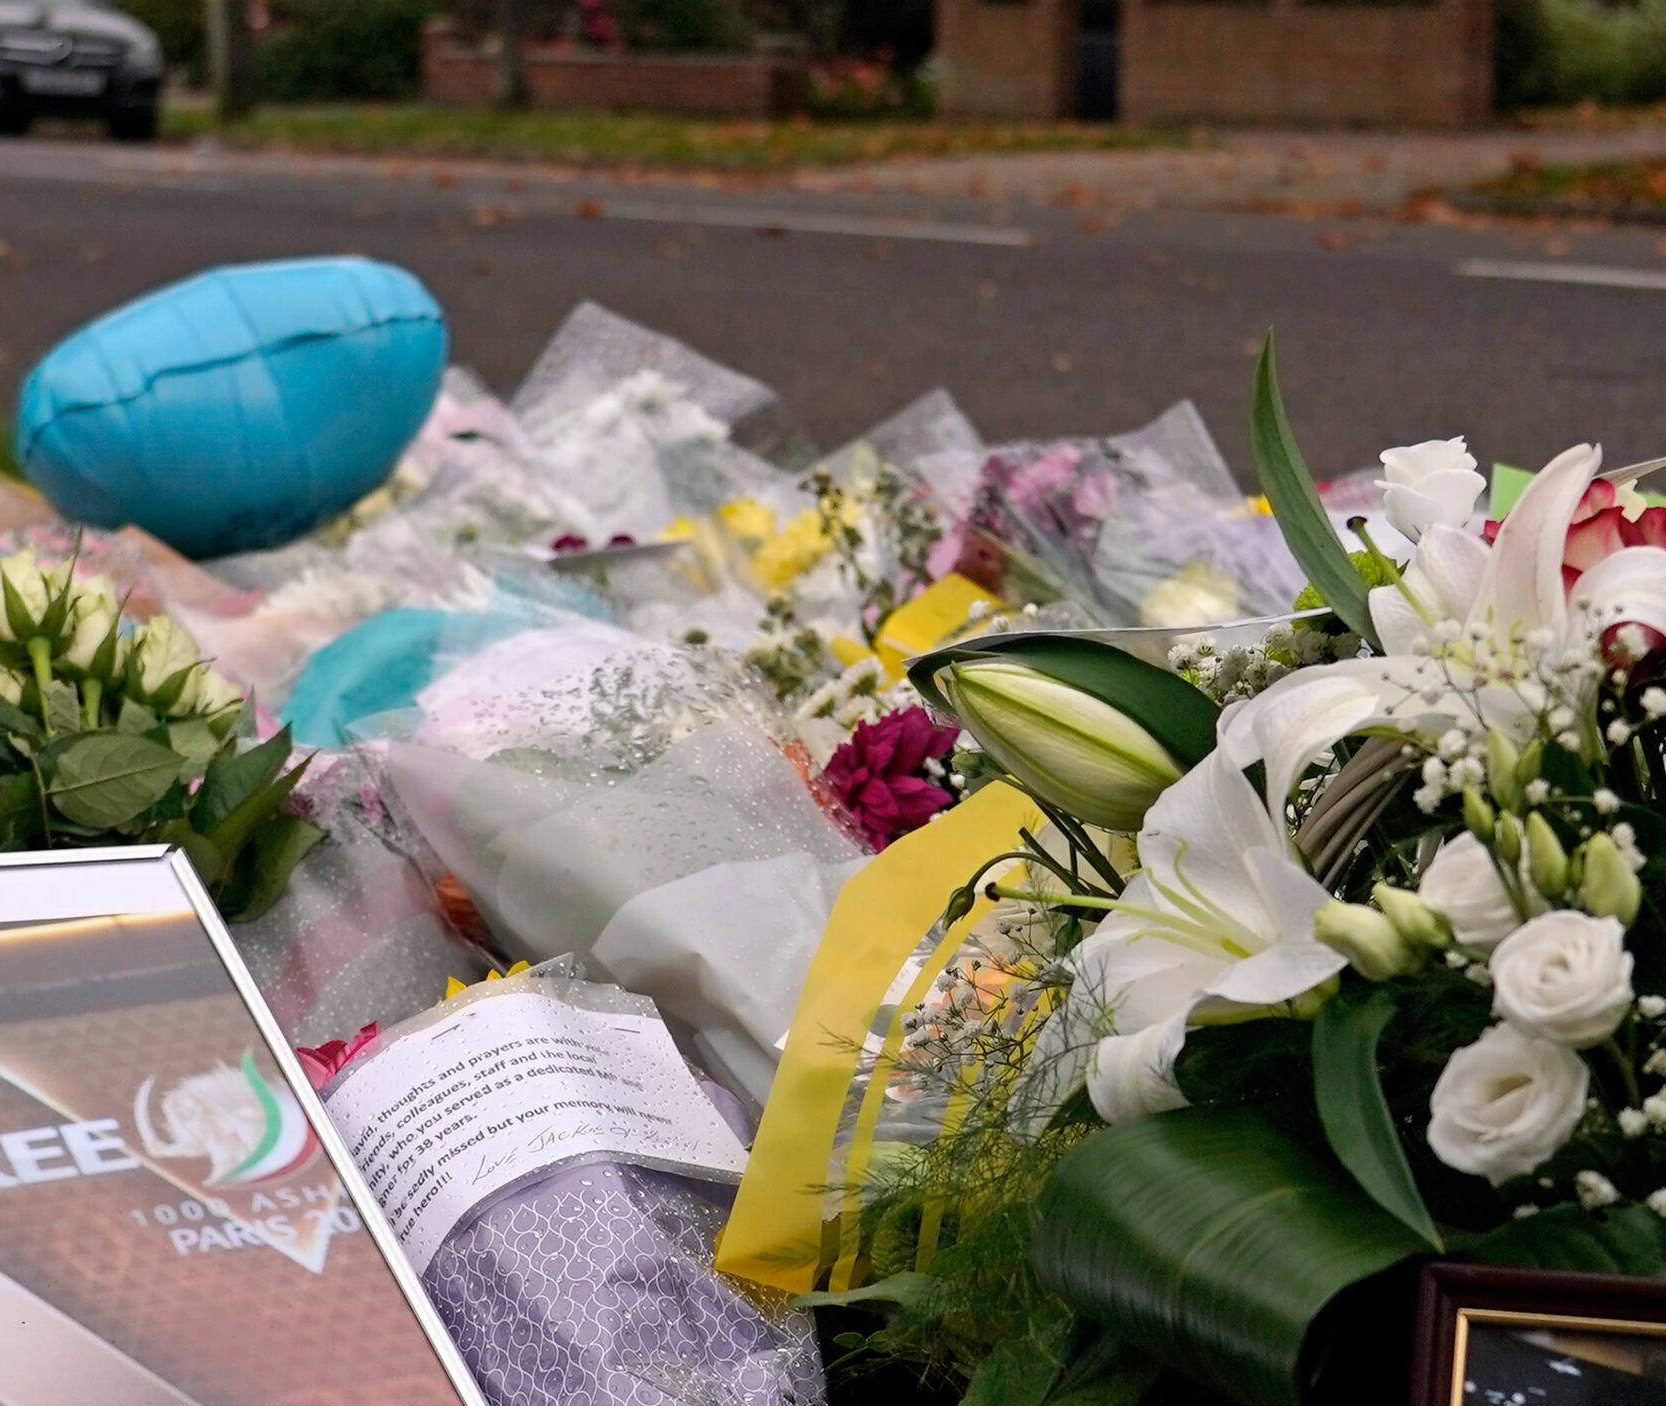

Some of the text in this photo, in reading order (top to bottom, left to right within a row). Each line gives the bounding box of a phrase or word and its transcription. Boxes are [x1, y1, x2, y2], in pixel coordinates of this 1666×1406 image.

[360, 1049, 597, 1172] riends, colleagues, staff and the local
[377, 1079, 437, 1124] thoughts
[438, 1061, 466, 1081] and
[468, 1040, 523, 1067] prayers
[525, 1036, 549, 1046] are
[551, 1036, 583, 1048] with
[369, 1162, 390, 1191] nity,
[388, 1132, 415, 1160] who
[416, 1113, 443, 1135] you
[445, 1084, 493, 1116] served
[494, 1078, 512, 1090] as
[514, 1073, 524, 1082] a
[527, 1064, 595, 1079] dedicated
[397, 1154, 416, 1175] for
[416, 1138, 434, 1157] 38
[434, 1113, 478, 1141] years.
[437, 1130, 485, 1167] missed
[486, 1117, 514, 1135] but
[516, 1104, 551, 1123] your
[553, 1099, 613, 1113] memory
[614, 1105, 637, 1118] will
[130, 1196, 227, 1228] 1000
[168, 1214, 299, 1256] PARIS
[399, 1171, 453, 1244] rue hero!!!
